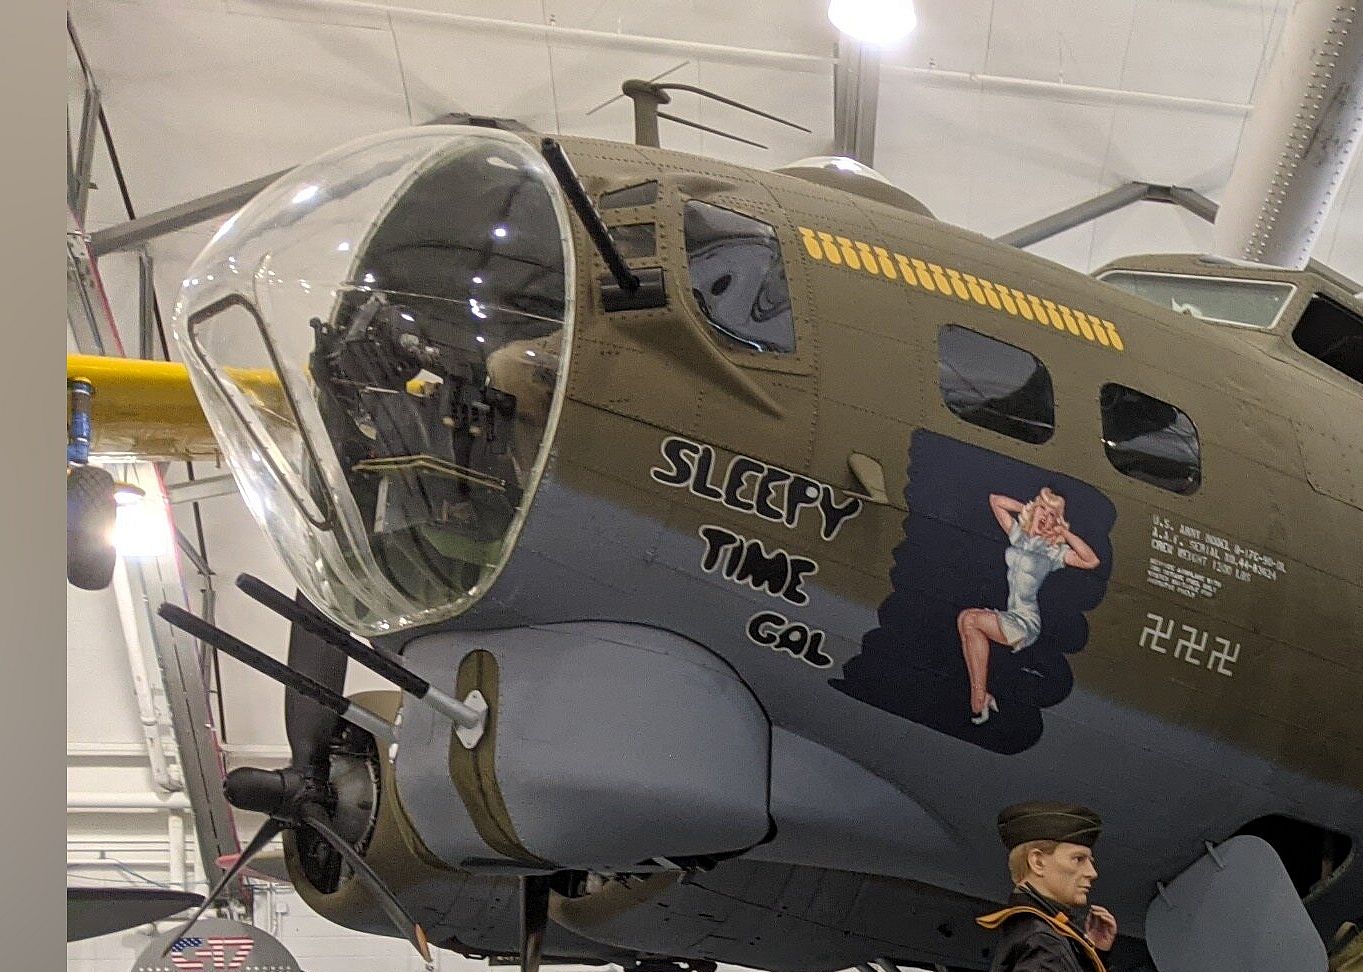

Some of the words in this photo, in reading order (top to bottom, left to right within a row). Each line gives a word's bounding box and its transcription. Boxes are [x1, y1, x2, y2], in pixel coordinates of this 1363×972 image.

[650, 436, 863, 541] SLEEPY
[699, 524, 819, 607] TIME
[746, 610, 833, 668] GAL
